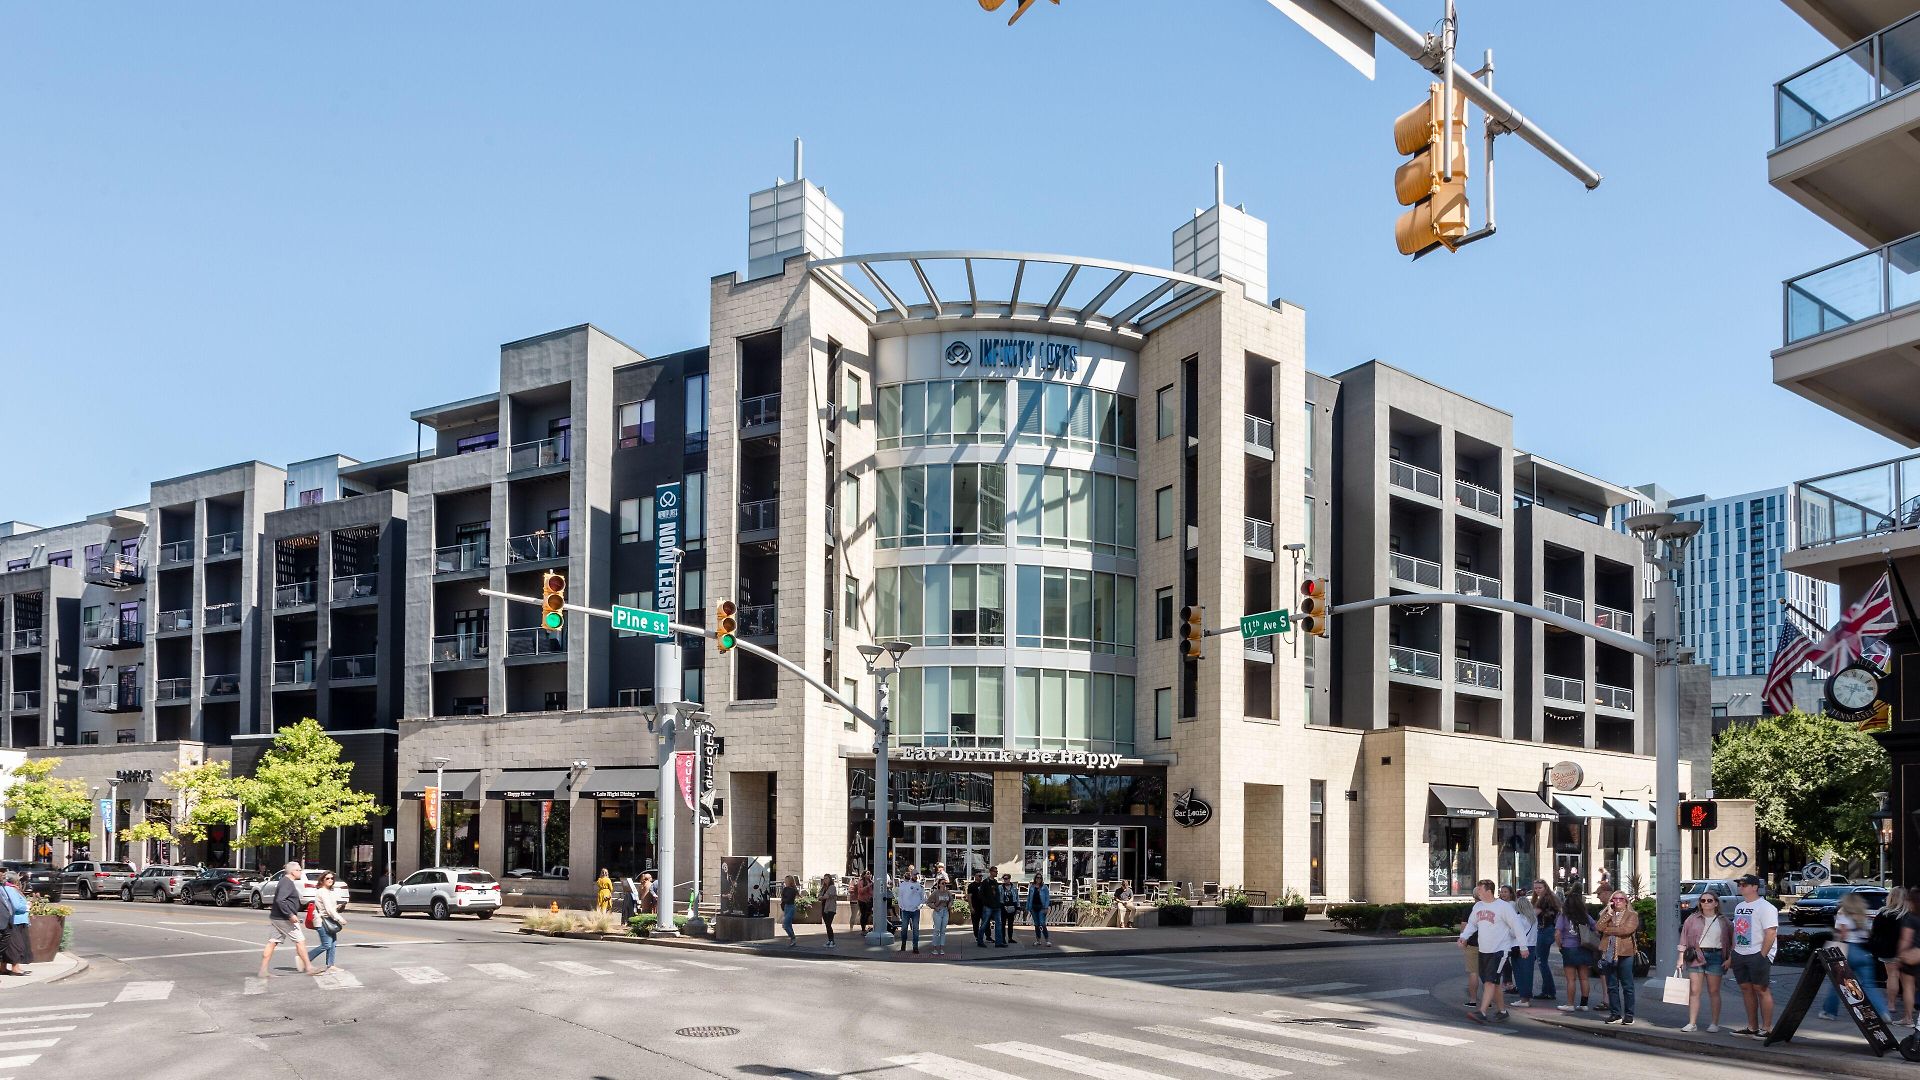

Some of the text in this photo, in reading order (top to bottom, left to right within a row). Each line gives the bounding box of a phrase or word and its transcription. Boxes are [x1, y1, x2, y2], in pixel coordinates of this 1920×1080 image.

[980, 338, 1078, 372] INFINITY LOFTS
[658, 522, 677, 564] NOW
[617, 609, 665, 632] Pine St
[658, 568, 676, 639] LEASI
[1244, 616, 1287, 634] 11th Ave S
[705, 734, 715, 789] Louie
[900, 746, 1122, 769] Eat Drink Be Happy
[684, 761, 692, 801] GULCH
[1174, 808, 1207, 817] Bar Louie
